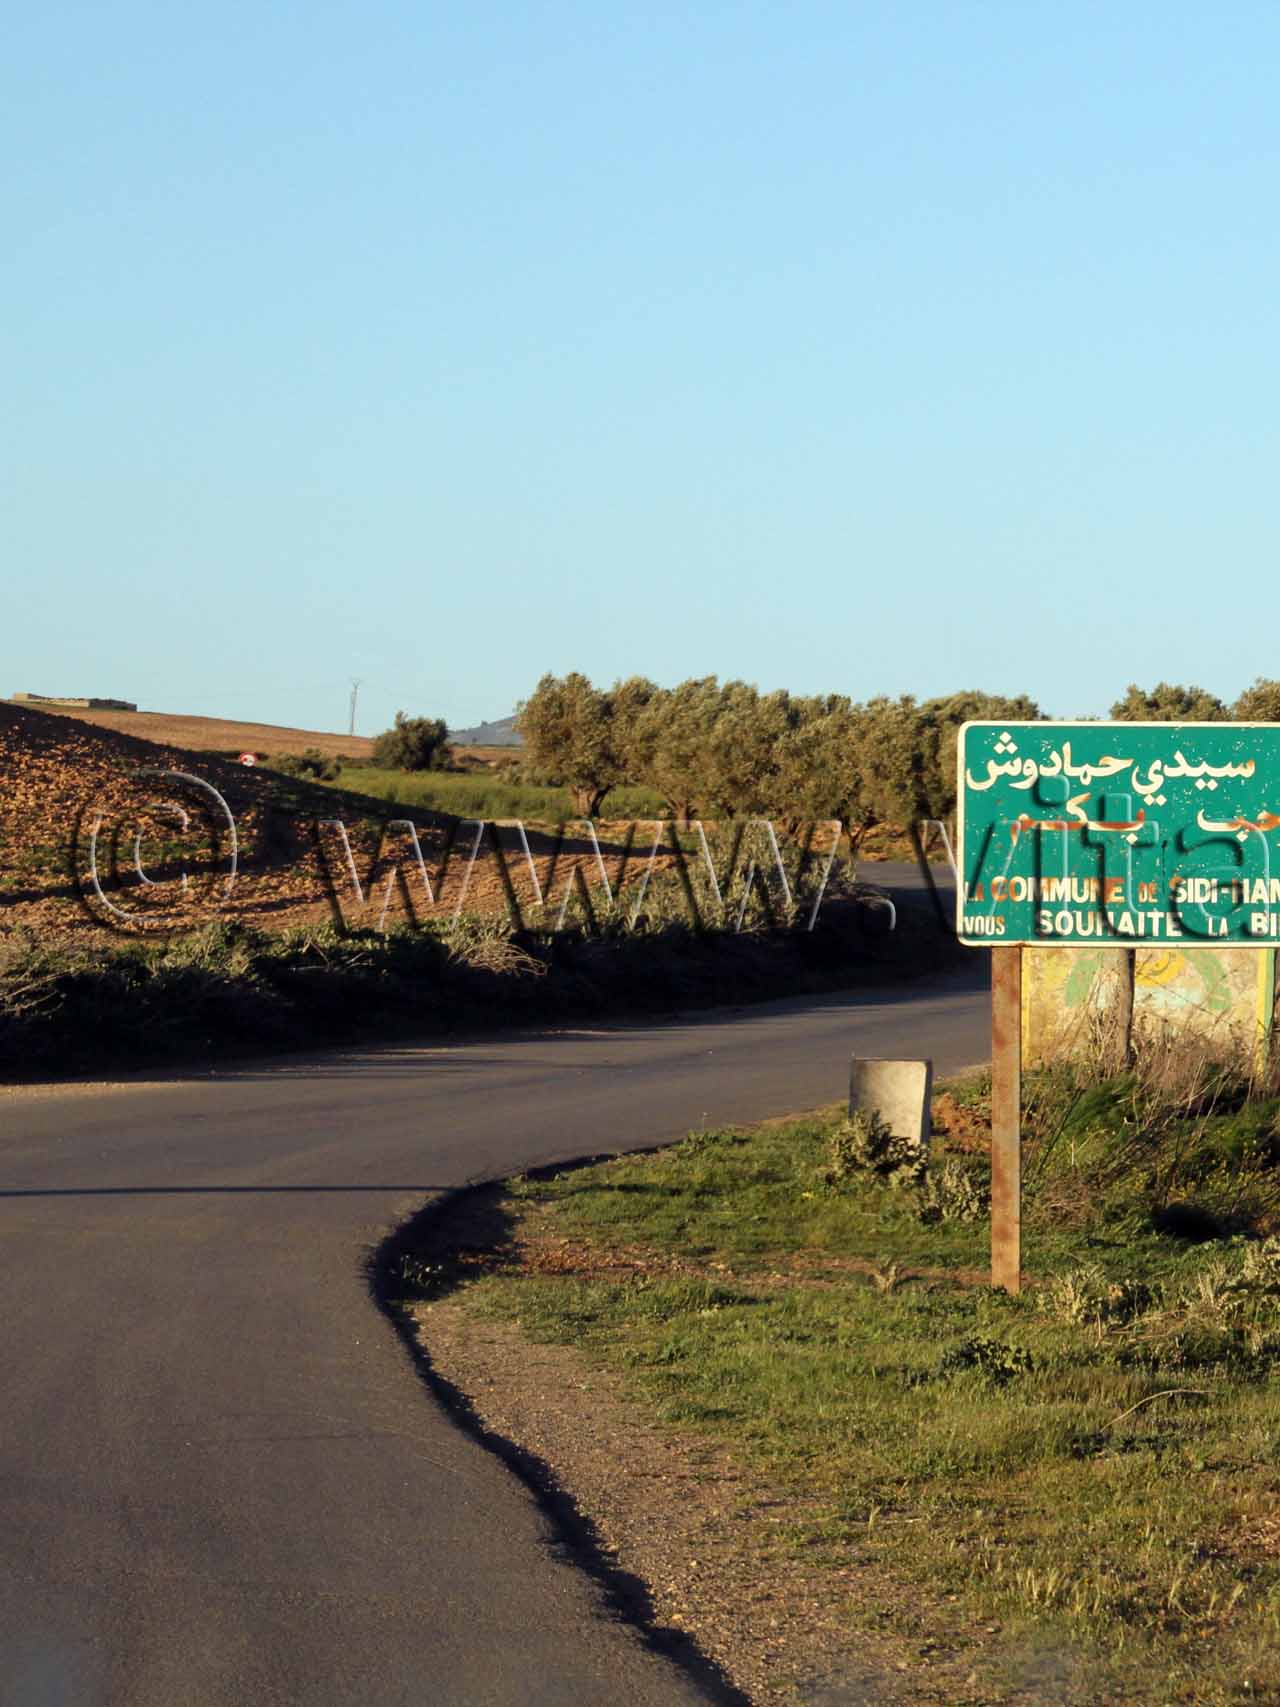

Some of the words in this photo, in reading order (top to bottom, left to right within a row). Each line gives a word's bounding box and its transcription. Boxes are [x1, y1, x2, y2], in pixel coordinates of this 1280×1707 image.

[966, 731, 1134, 791] حمادوش
[1131, 751, 1256, 806] سيدي
[1010, 792, 1146, 848] بكم
[991, 876, 1125, 903] COMMUNE
[963, 915, 1006, 936] VOUS
[1039, 909, 1184, 937] SOUHAITE
[1207, 917, 1229, 937] LA
